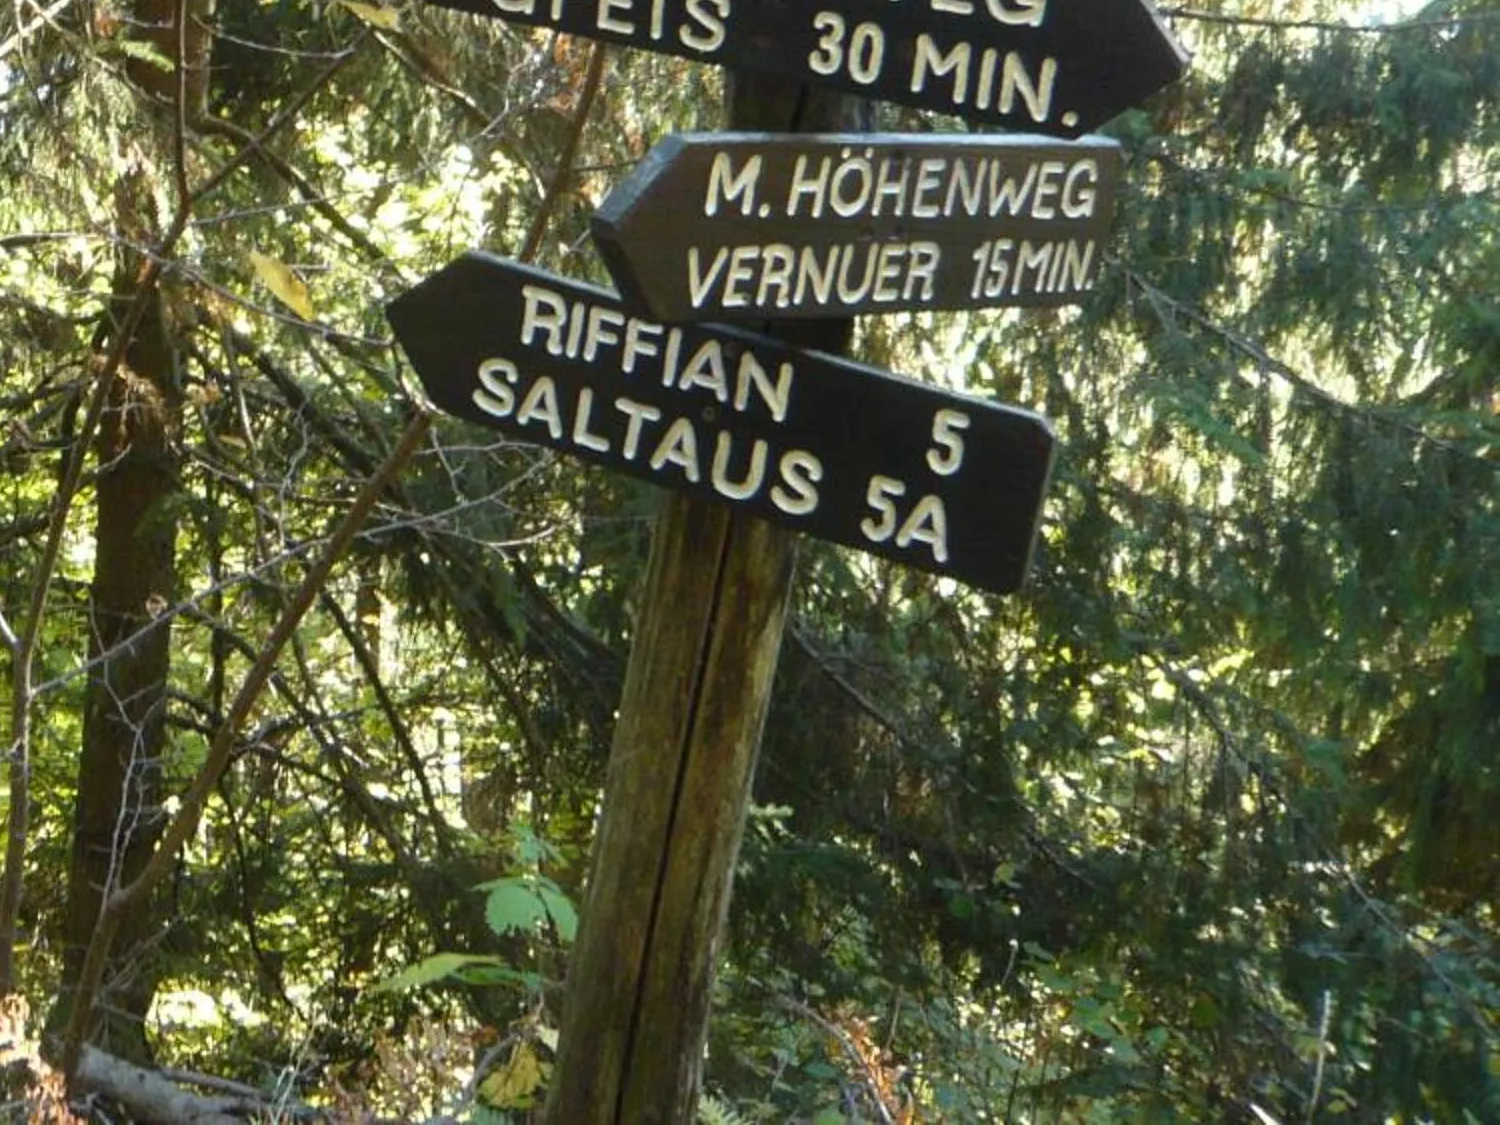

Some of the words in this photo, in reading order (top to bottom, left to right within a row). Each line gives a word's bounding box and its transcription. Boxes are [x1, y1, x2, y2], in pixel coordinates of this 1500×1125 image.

[808, 9, 885, 86] 30
[910, 32, 1079, 128] MIN.
[704, 151, 770, 218] M.
[786, 146, 1098, 220] HÖHENWEG
[687, 240, 941, 308] VERNUER
[519, 284, 794, 424] RIFFIAN
[925, 408, 971, 476] 5
[471, 358, 823, 516] SALTAUS
[859, 475, 951, 564] 5A
